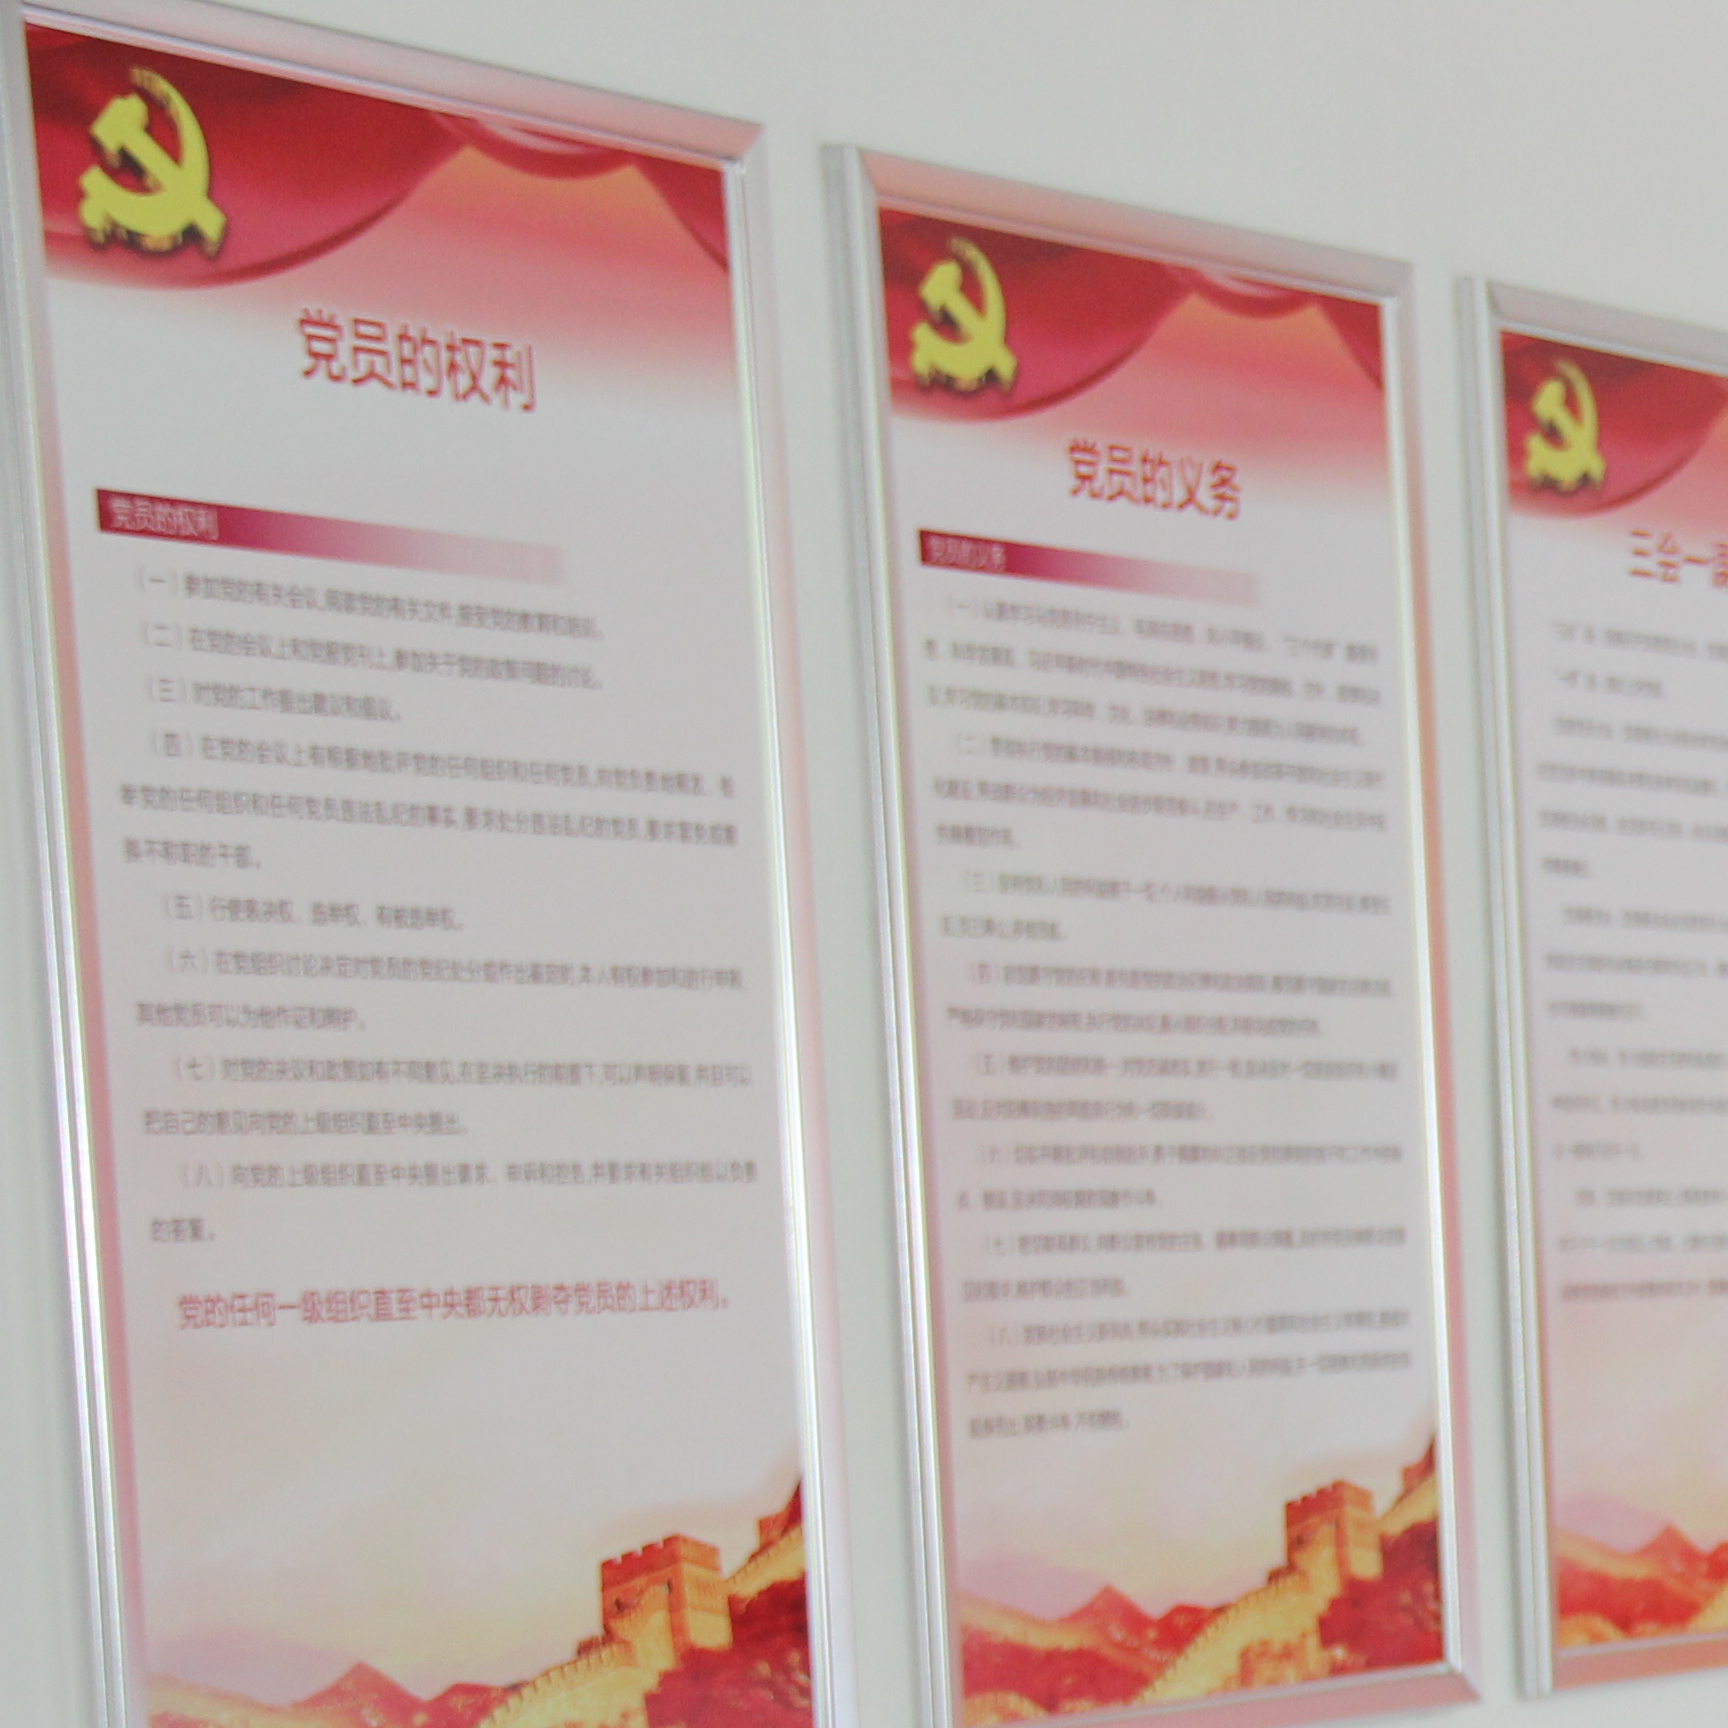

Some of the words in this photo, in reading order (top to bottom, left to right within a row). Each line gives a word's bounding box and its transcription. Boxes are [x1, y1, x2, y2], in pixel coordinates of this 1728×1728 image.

[297, 307, 538, 412] 党员的权利
[110, 495, 220, 541] 党员的权利
[1068, 438, 1242, 520] 党员的义务
